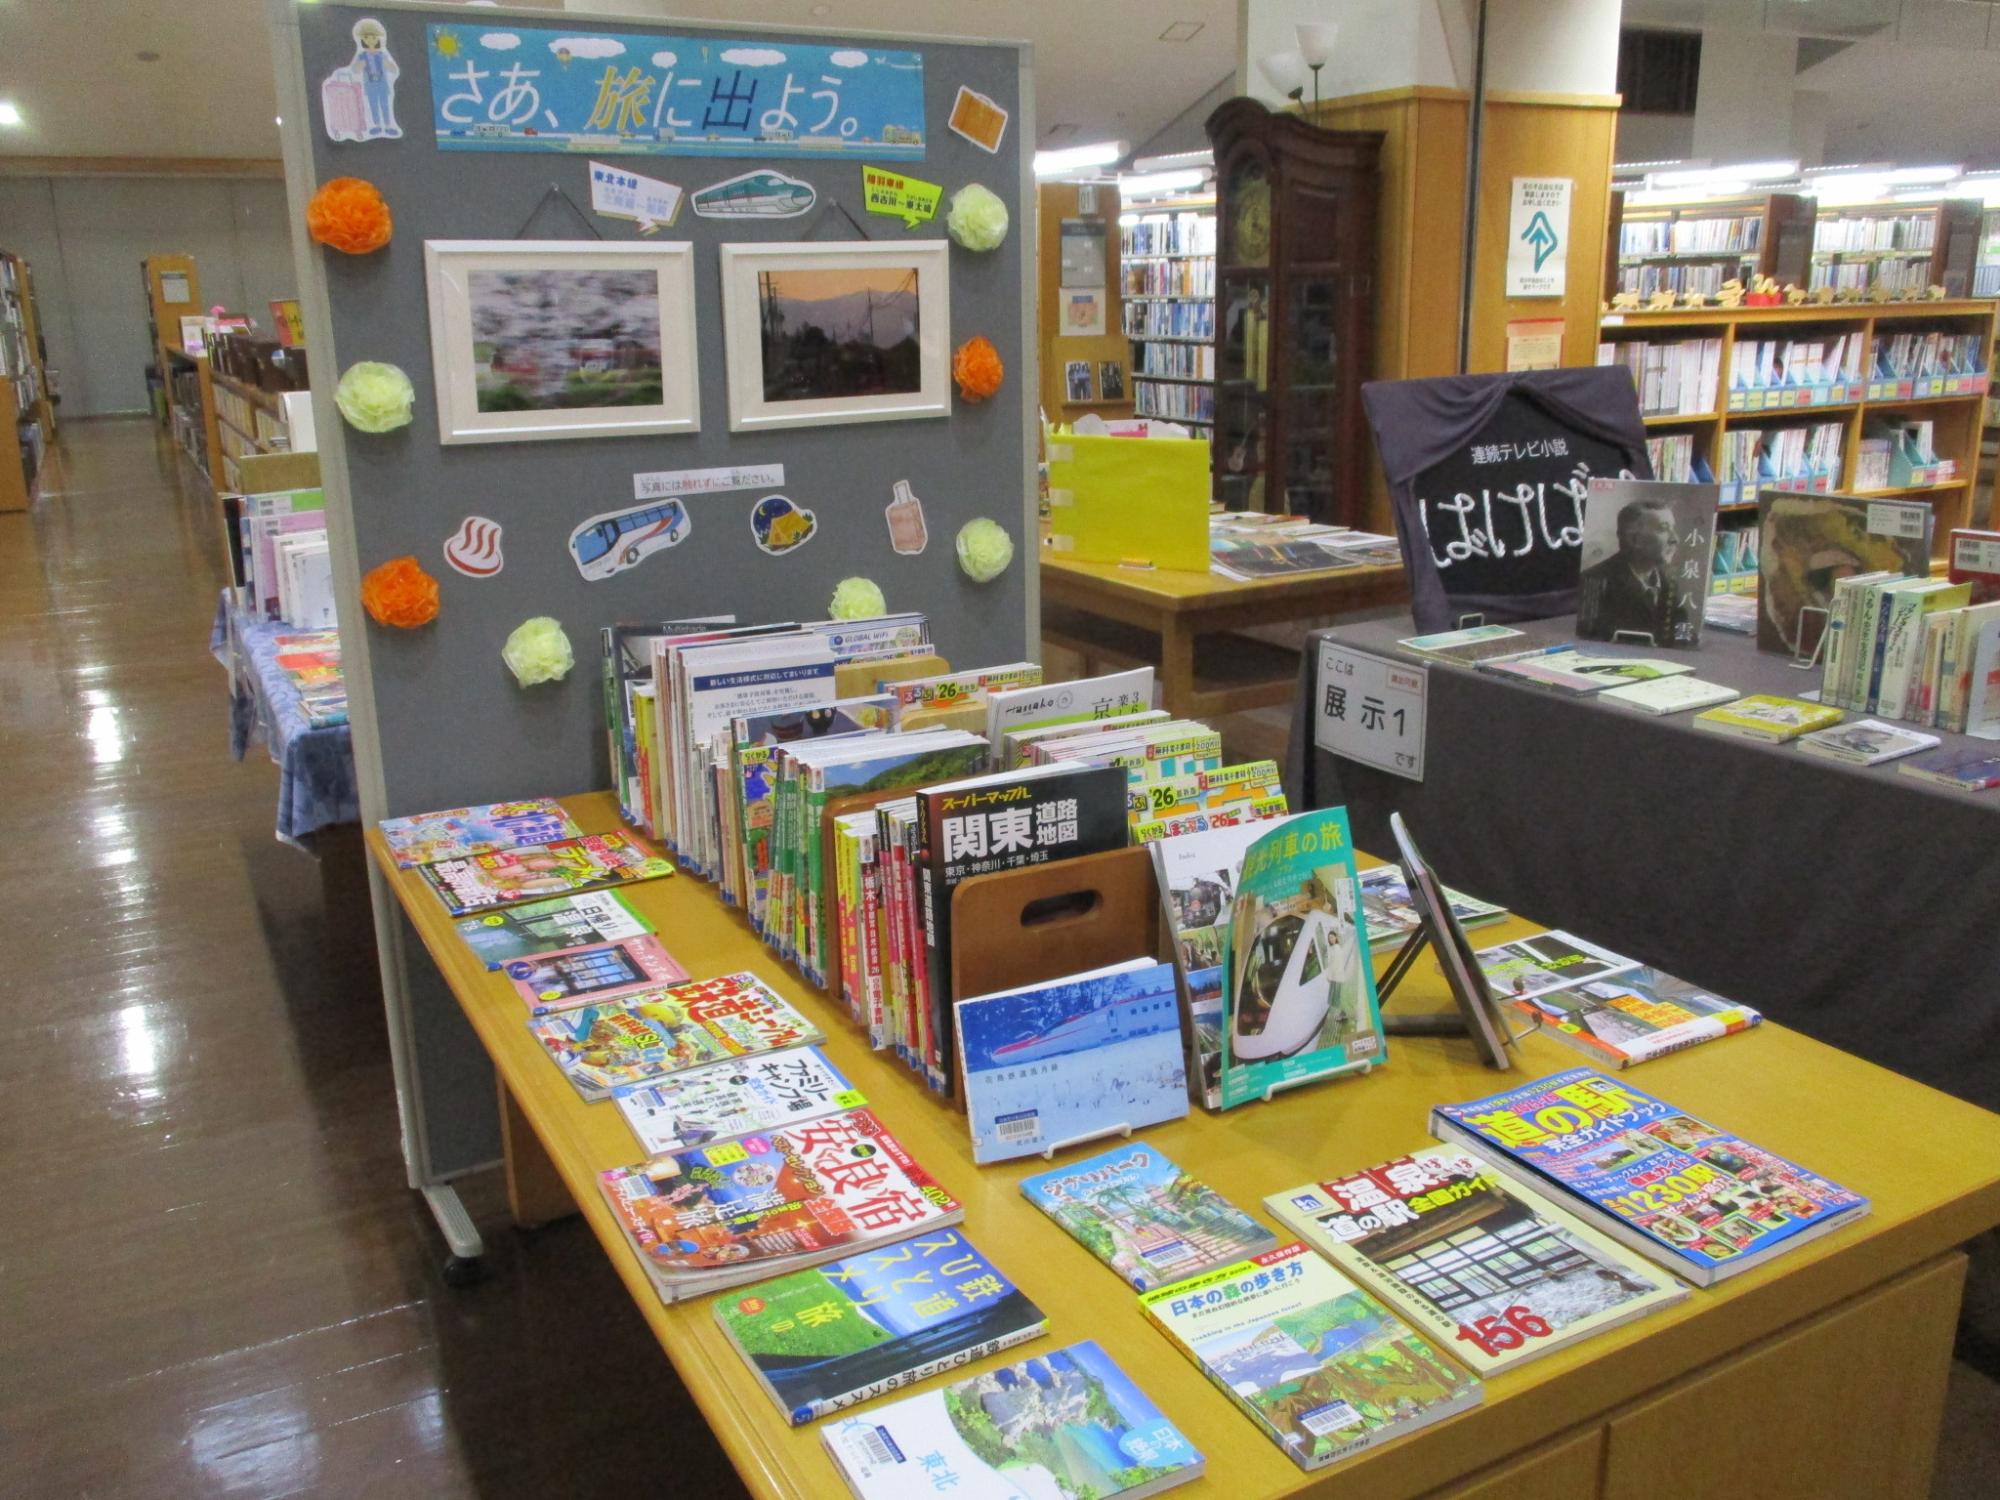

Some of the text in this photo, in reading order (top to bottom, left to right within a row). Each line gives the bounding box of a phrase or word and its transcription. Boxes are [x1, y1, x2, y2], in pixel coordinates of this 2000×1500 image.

[441, 60, 860, 136] さあ、旅に出よう。
[1471, 438, 1569, 465] 連続テレビ小説
[1674, 528, 1704, 641] 小泉八雲
[709, 668, 819, 687] 新しい生活様式に対応してまいります
[1325, 656, 1355, 675] ここは
[1394, 752, 1417, 769] です
[942, 785, 1032, 811] スーパーマップル
[1036, 797, 1078, 826] 道路
[942, 807, 1034, 863] 関東
[1036, 821, 1078, 846] 地図
[864, 876, 877, 900] 栃木
[753, 1062, 813, 1110] キャンプ場
[780, 1059, 836, 1102] ファミリー
[1466, 1078, 1652, 1147] 道の駅
[1539, 1104, 1677, 1151] 完全ガイドブック
[788, 1118, 929, 1229] 安くて良い宿
[1331, 1164, 1438, 1208] 温泉
[1404, 1173, 1504, 1211] 全国ガイド
[674, 1189, 786, 1228] 満足旅
[1319, 1200, 1419, 1241] 道の駅
[821, 1233, 960, 1285] ススメ
[767, 1255, 983, 1336] ひとり旅の
[908, 1274, 1004, 1317] 鉄道
[1166, 1262, 1308, 1315] 日本の森の歩き方
[1454, 1305, 1553, 1357] 156
[832, 1339, 1001, 1411] 鉄道ひとり旅のススメ
[1151, 1428, 1184, 1450] 日本
[910, 1451, 967, 1489] 東北
